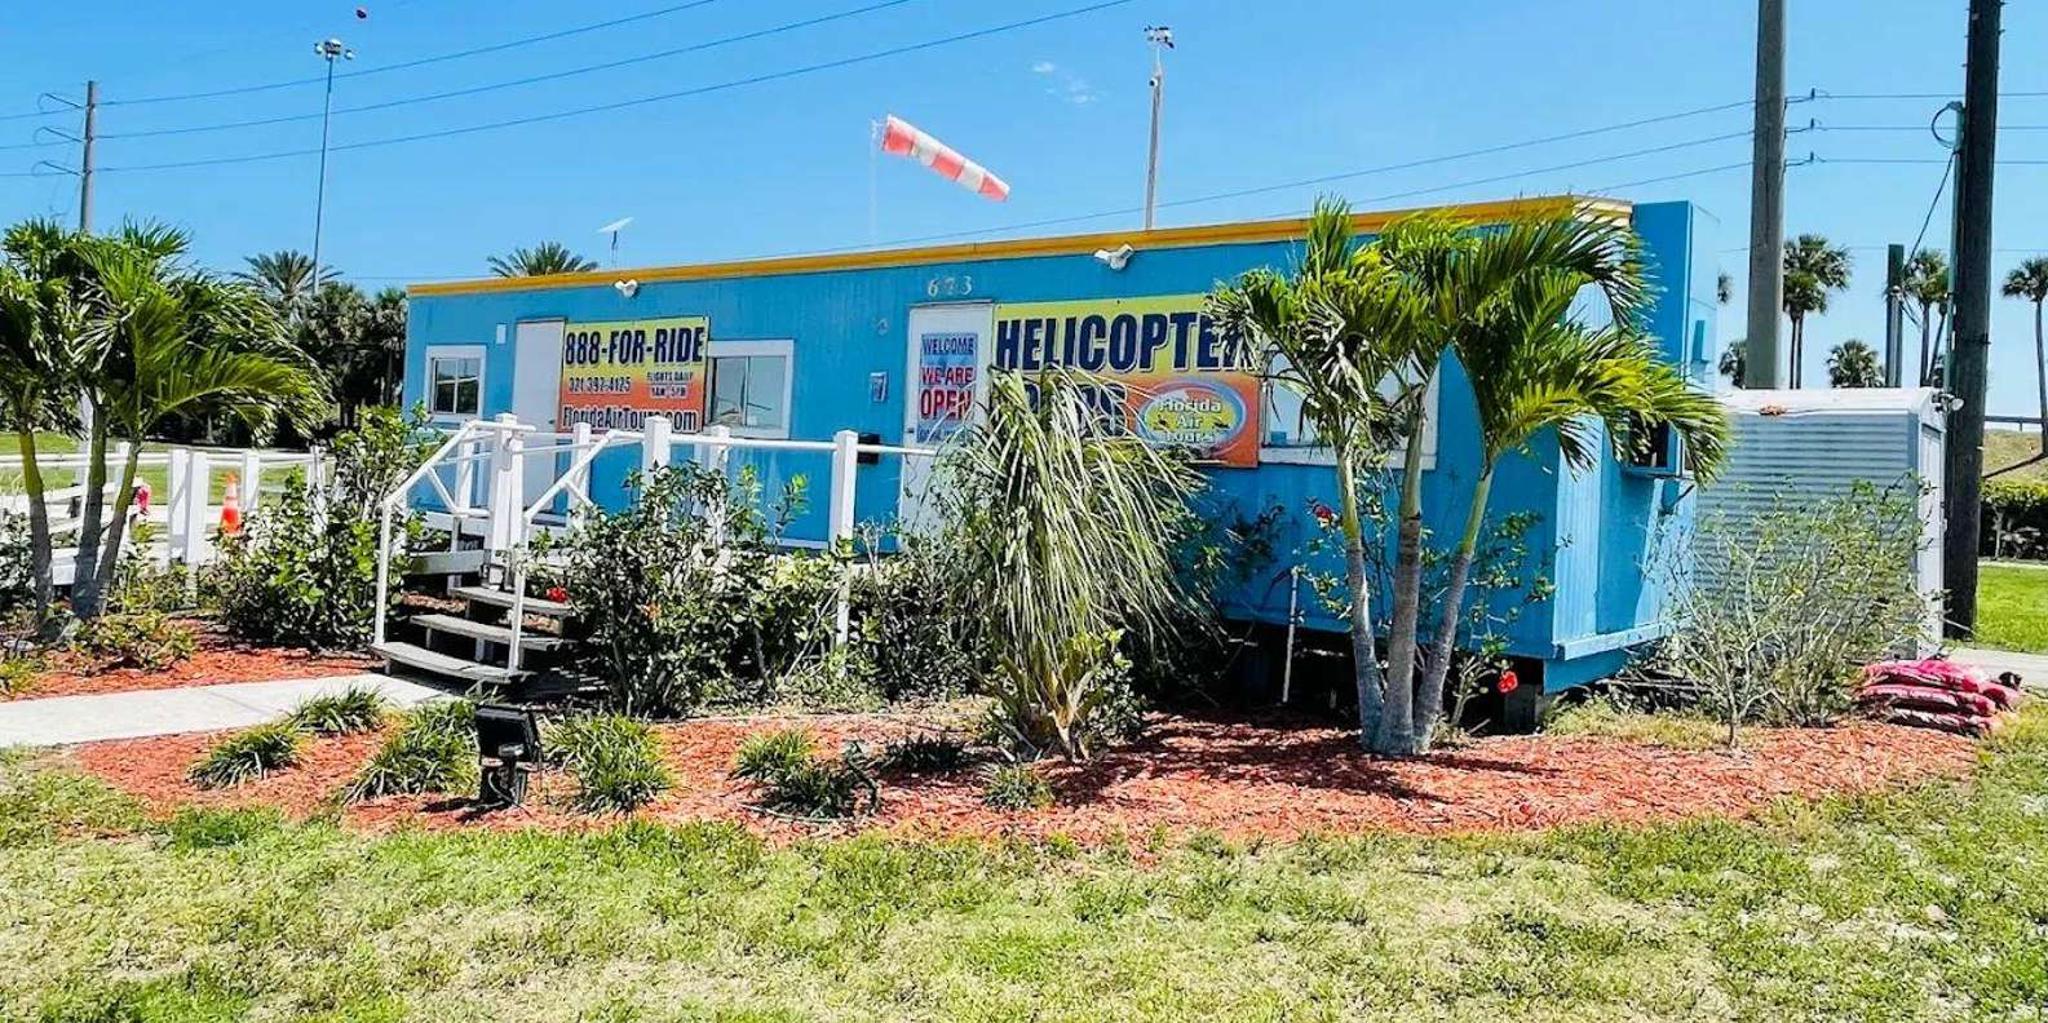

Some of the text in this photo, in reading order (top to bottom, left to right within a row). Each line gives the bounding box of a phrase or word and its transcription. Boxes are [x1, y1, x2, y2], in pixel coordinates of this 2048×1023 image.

[565, 327, 705, 365] 888-FOR-RIDE
[922, 337, 975, 355] WELCOME
[921, 367, 973, 386] WE ARE
[920, 389, 972, 421] OPEN
[1160, 397, 1222, 413] Florida
[1177, 414, 1203, 429] Air
